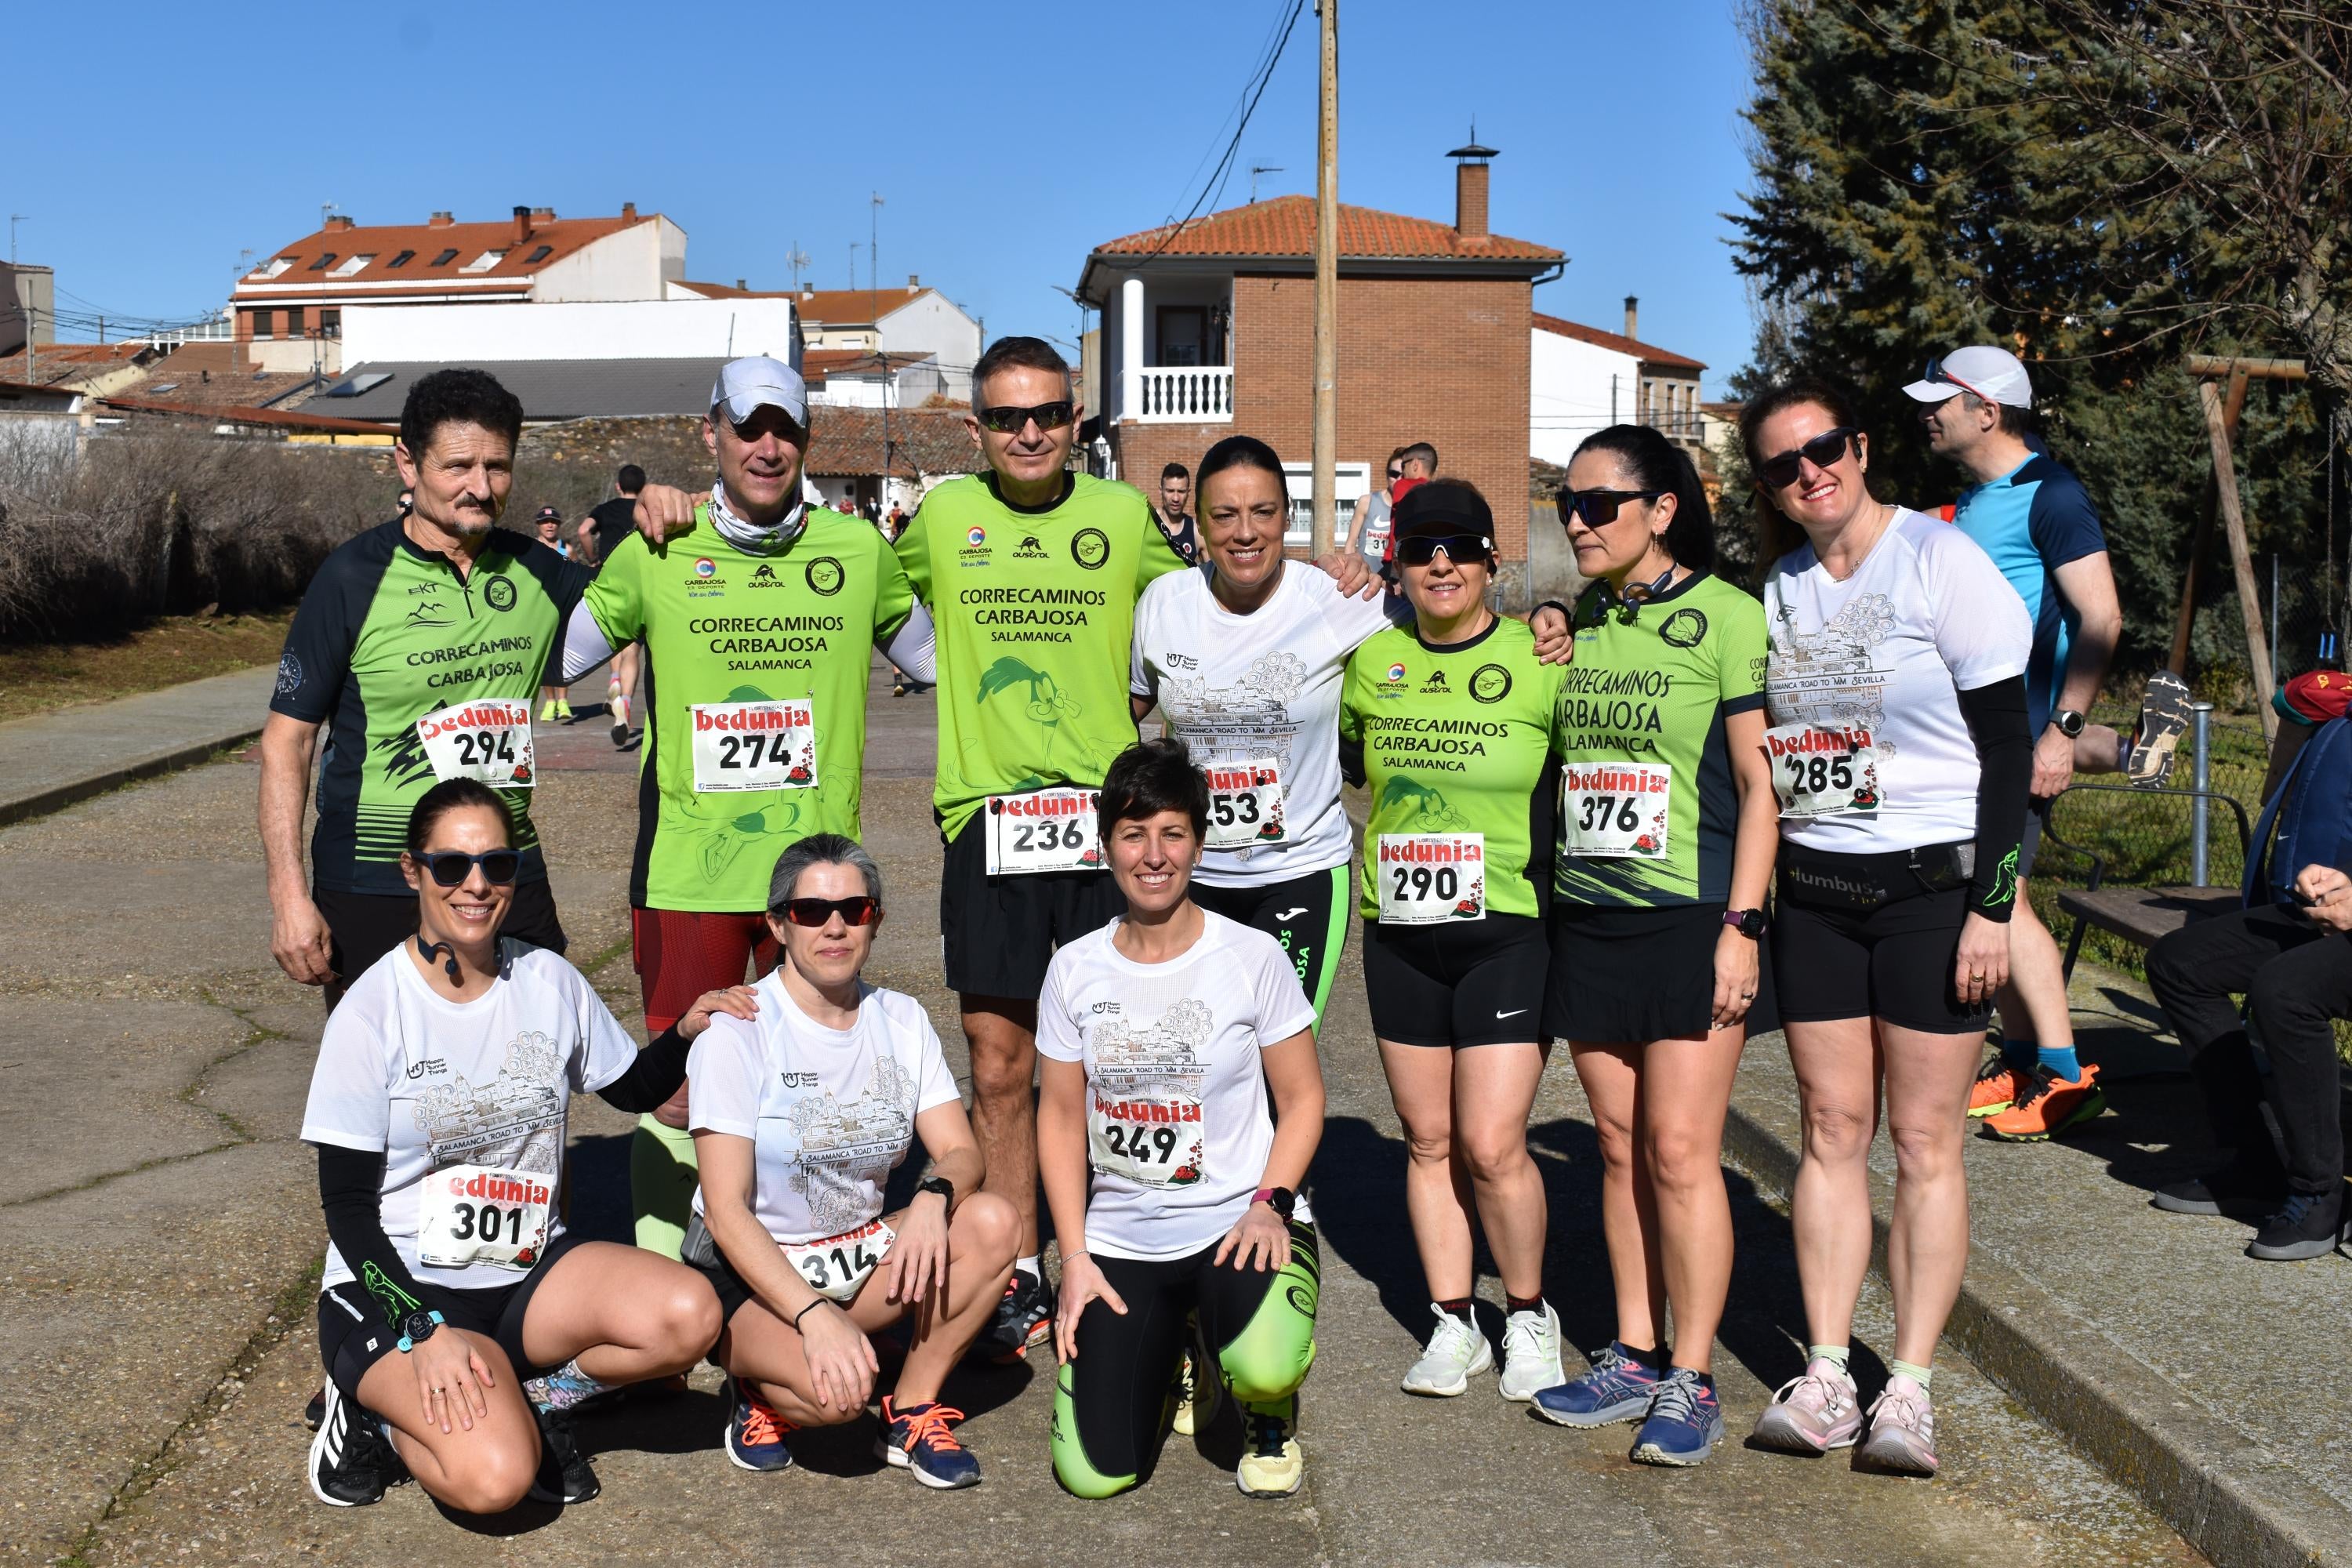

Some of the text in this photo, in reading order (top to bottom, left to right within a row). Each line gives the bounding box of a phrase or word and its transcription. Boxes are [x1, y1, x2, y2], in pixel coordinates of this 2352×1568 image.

[1075, 528, 1109, 543] CORRECAMINOS
[960, 588, 1105, 606] CORRECAMINOS
[689, 616, 844, 634] CORRECAMINOS
[975, 609, 1088, 626] CARBAJOSA
[710, 637, 829, 654] CARBAJOSA
[991, 631, 1073, 643] SALAMANCA
[406, 636, 532, 666] CORRECAMINOS
[426, 661, 524, 688] CARBAJOSA
[728, 659, 812, 671] SALAMANCA
[1559, 668, 1674, 698] ORRECAMINOS
[1766, 682, 1797, 691] SALAMANCA
[1801, 680, 1818, 689] ROAD
[1852, 675, 1886, 685] SEVILLA
[420, 704, 528, 741] bedunia
[696, 706, 811, 731] bedunia
[1369, 717, 1508, 738] CORRECAMINOS
[1557, 699, 1662, 733] ARBAJOSA
[1176, 726, 1214, 735] SALAMANCA
[1269, 725, 1298, 735] SEVILLA
[1766, 727, 1872, 757] bedunia
[454, 730, 515, 765] 294
[720, 733, 792, 769] 274
[1374, 736, 1486, 757] CARBAJOSA
[1563, 735, 1659, 753] ALAMANCA
[1383, 757, 1466, 771] SALAMANCA
[1791, 755, 1853, 796] 285
[1206, 766, 1278, 790] dunia
[1568, 768, 1667, 793] bedunia
[1208, 792, 1260, 826] 53
[1579, 797, 1639, 832] 376
[1013, 819, 1083, 852] 236
[1381, 840, 1481, 862] bedunia
[1393, 867, 1457, 901] 290
[1094, 1091, 1201, 1123] bedunia
[437, 1137, 486, 1154] SALAMANCA
[489, 1130, 511, 1141] ROAD
[513, 1126, 524, 1134] TO
[543, 1116, 565, 1129] SEVILLA
[1105, 1125, 1177, 1164] 249
[806, 1150, 851, 1163] SALAMANCA
[853, 1147, 871, 1157] ROAD
[448, 1173, 550, 1206] edunia
[449, 1203, 522, 1245] 301
[803, 1244, 880, 1289] 314
